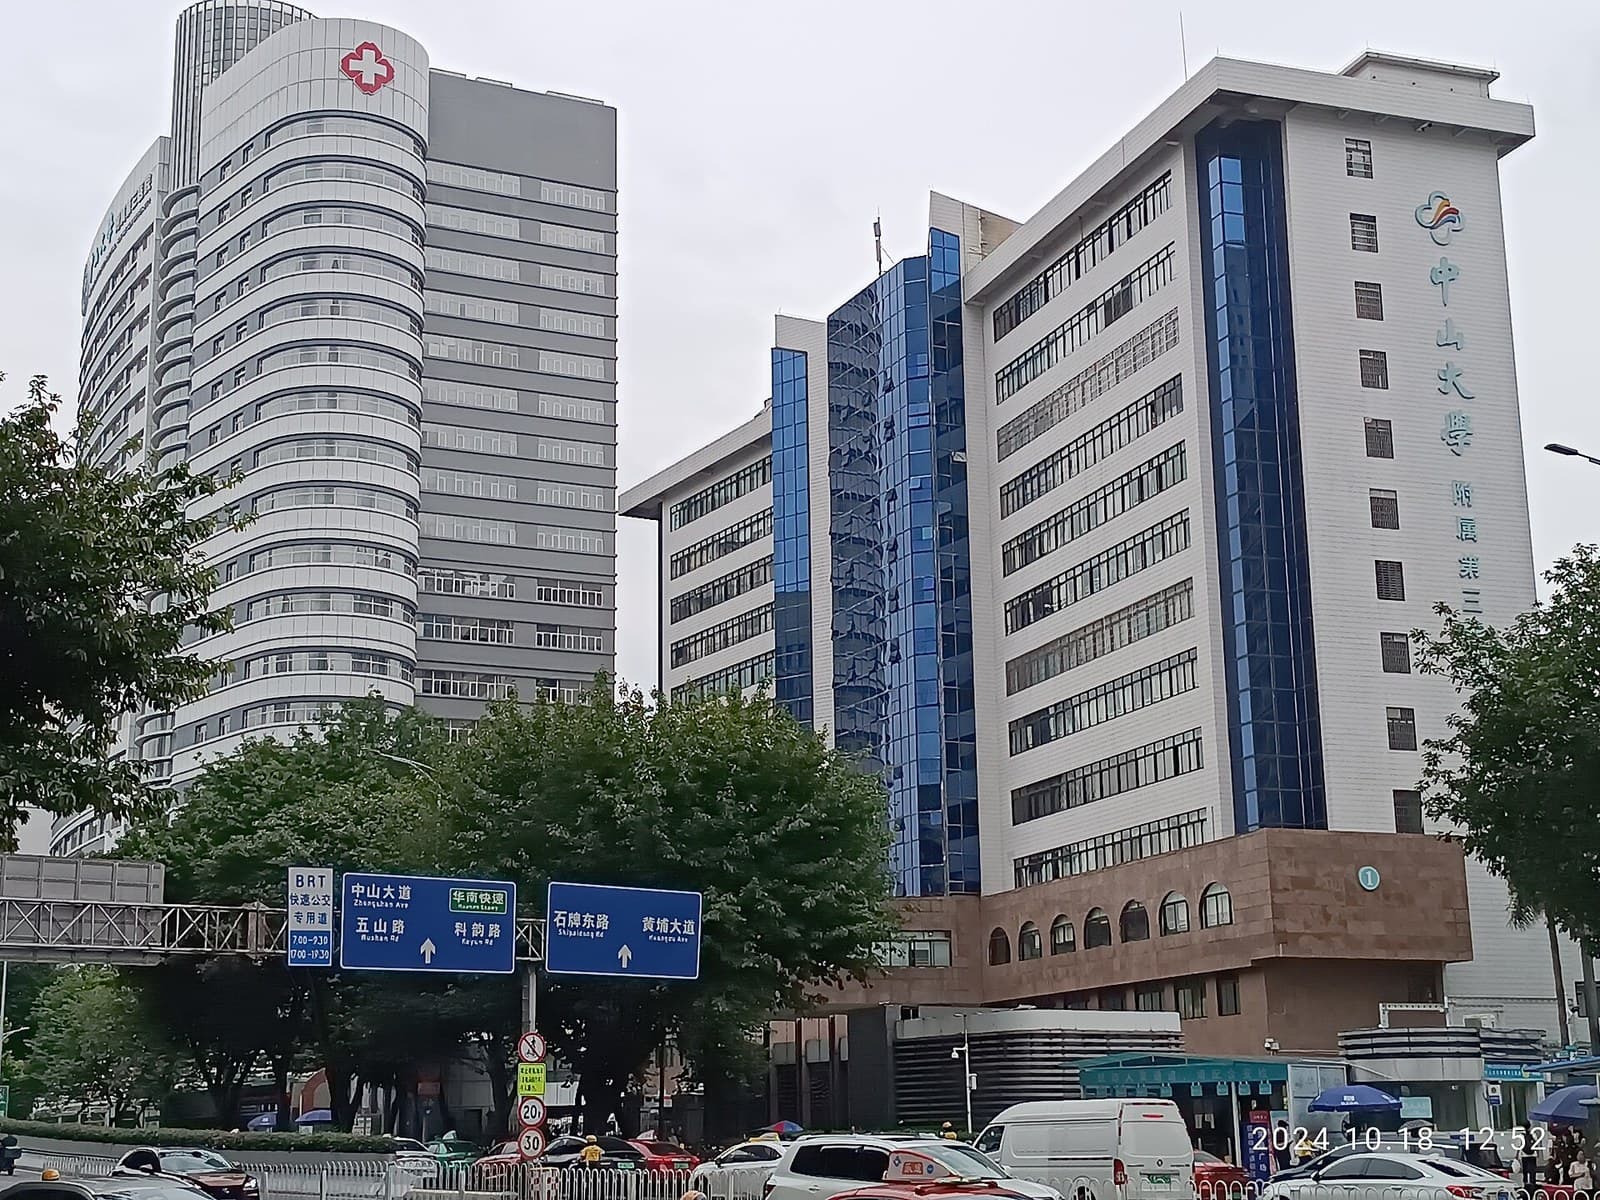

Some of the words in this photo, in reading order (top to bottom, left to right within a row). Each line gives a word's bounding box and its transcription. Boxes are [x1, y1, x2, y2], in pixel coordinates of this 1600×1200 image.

[296, 874, 326, 888] BRT
[1365, 870, 1374, 886] 1
[351, 882, 412, 900] 中山大道
[452, 890, 504, 905] 华南快速
[290, 893, 331, 906] 快速公交
[294, 911, 328, 925] 专用道
[355, 916, 405, 934] 五山路
[553, 910, 609, 930] 石牌东路
[642, 916, 695, 935] 黄埔大道
[454, 921, 501, 938] 科韵路
[523, 1135, 540, 1151] 30
